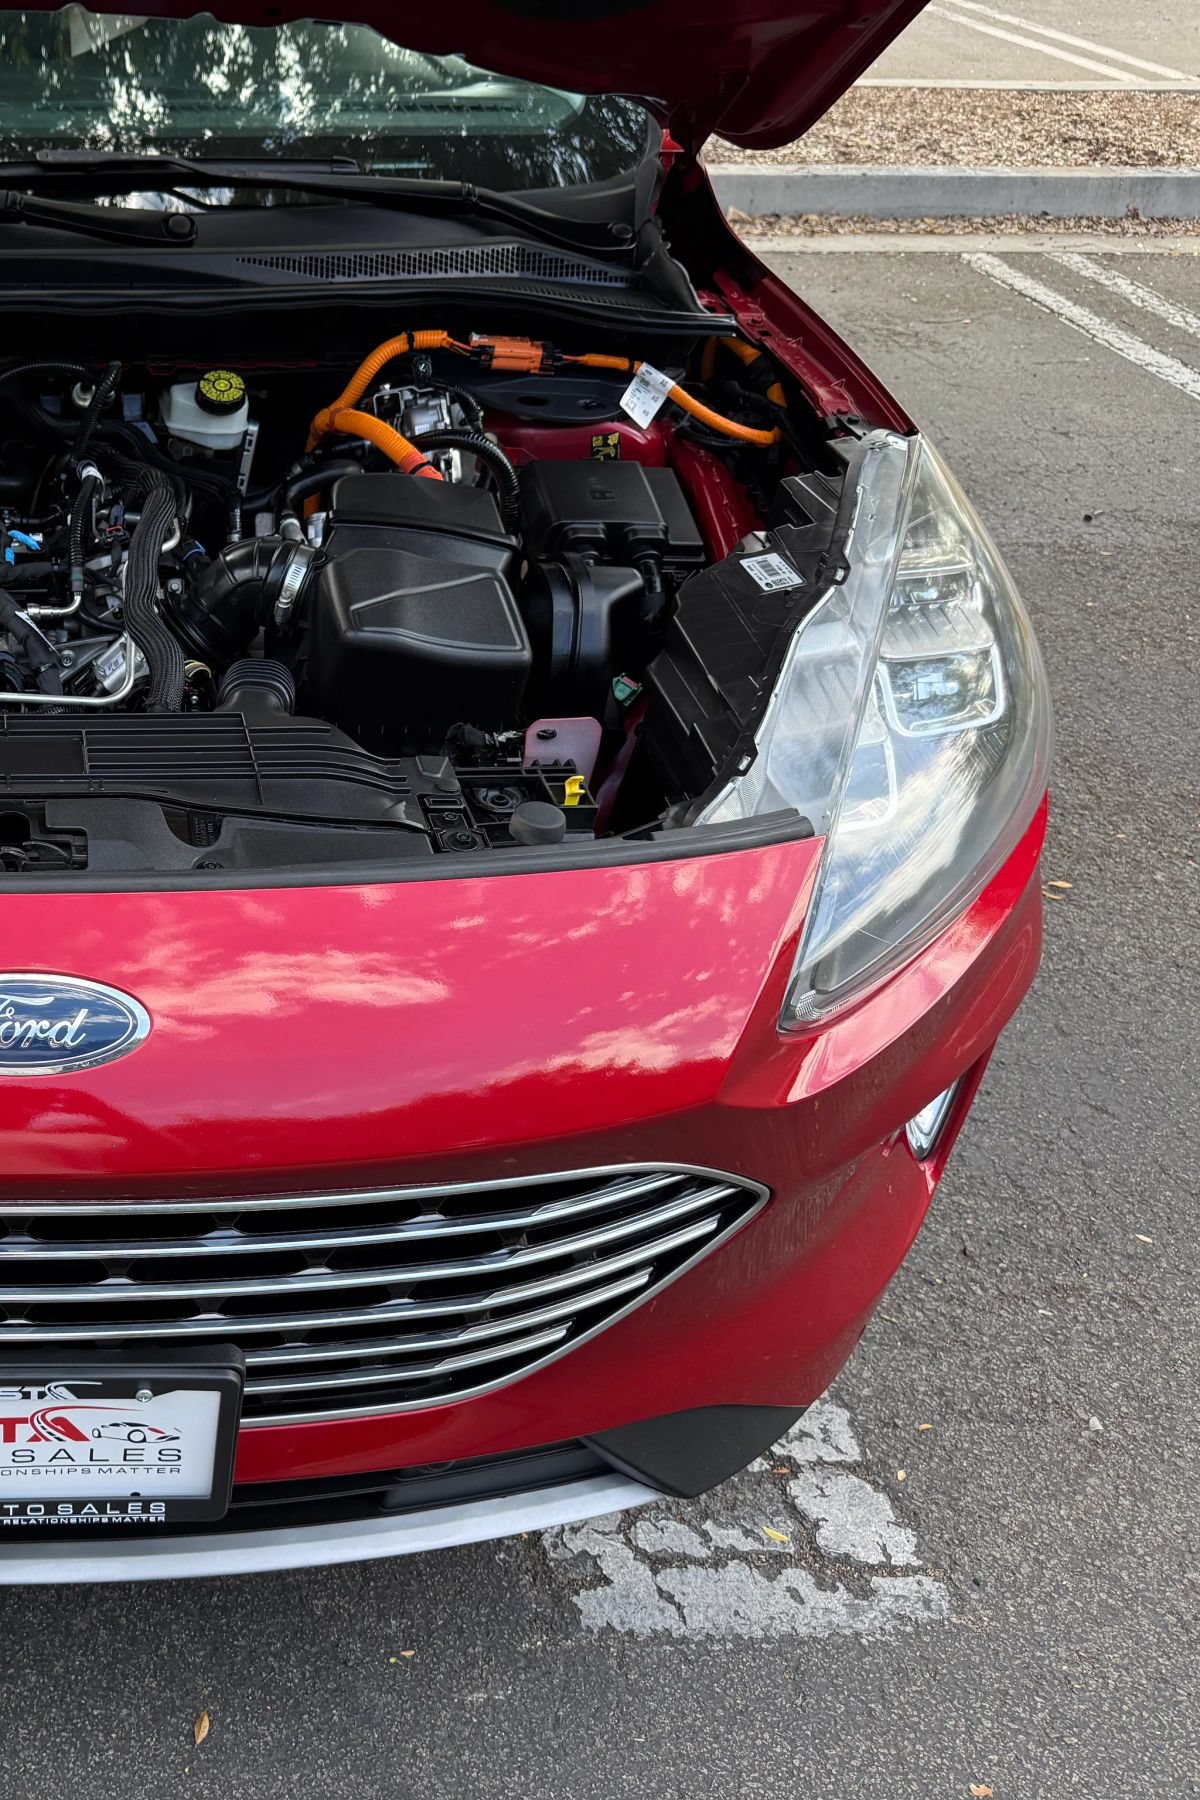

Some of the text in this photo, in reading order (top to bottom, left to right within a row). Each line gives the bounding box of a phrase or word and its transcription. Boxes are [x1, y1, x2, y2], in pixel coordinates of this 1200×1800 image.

[11, 1448, 182, 1464] SALES
[57, 1502, 166, 1515] SALES
[3, 1516, 108, 1525] RELATIONSHIPS
[112, 1515, 165, 1523] MATTER
